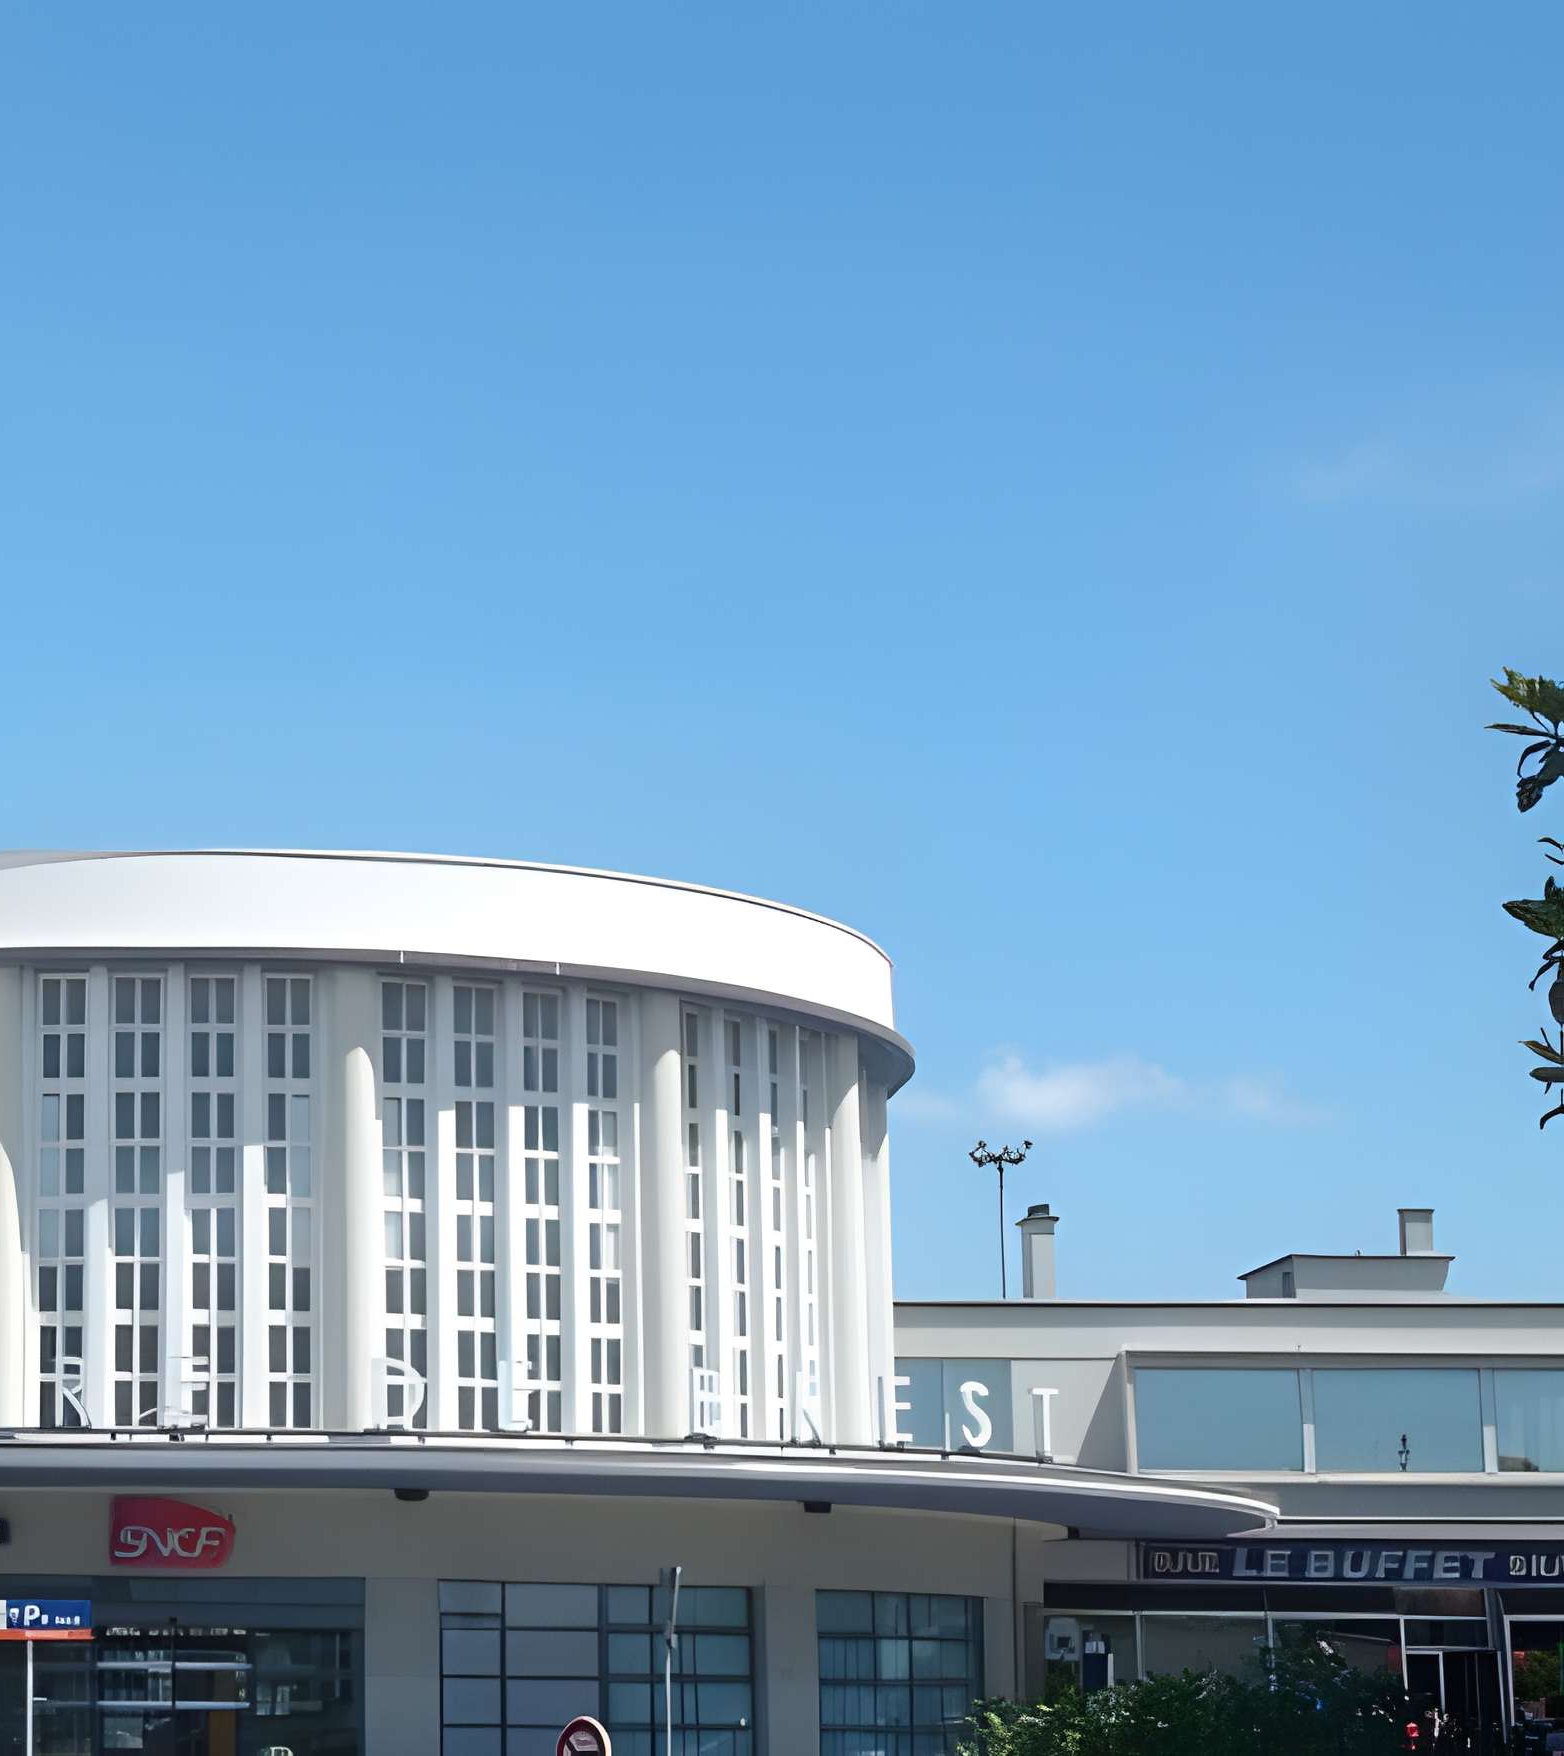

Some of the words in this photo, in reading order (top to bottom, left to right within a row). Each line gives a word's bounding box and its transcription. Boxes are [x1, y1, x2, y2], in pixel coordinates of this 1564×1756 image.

[370, 1357, 534, 1433] DE
[114, 1524, 228, 1558] SNCF
[1232, 1548, 1290, 1578] LE
[1304, 1550, 1497, 1580] BUFFET
